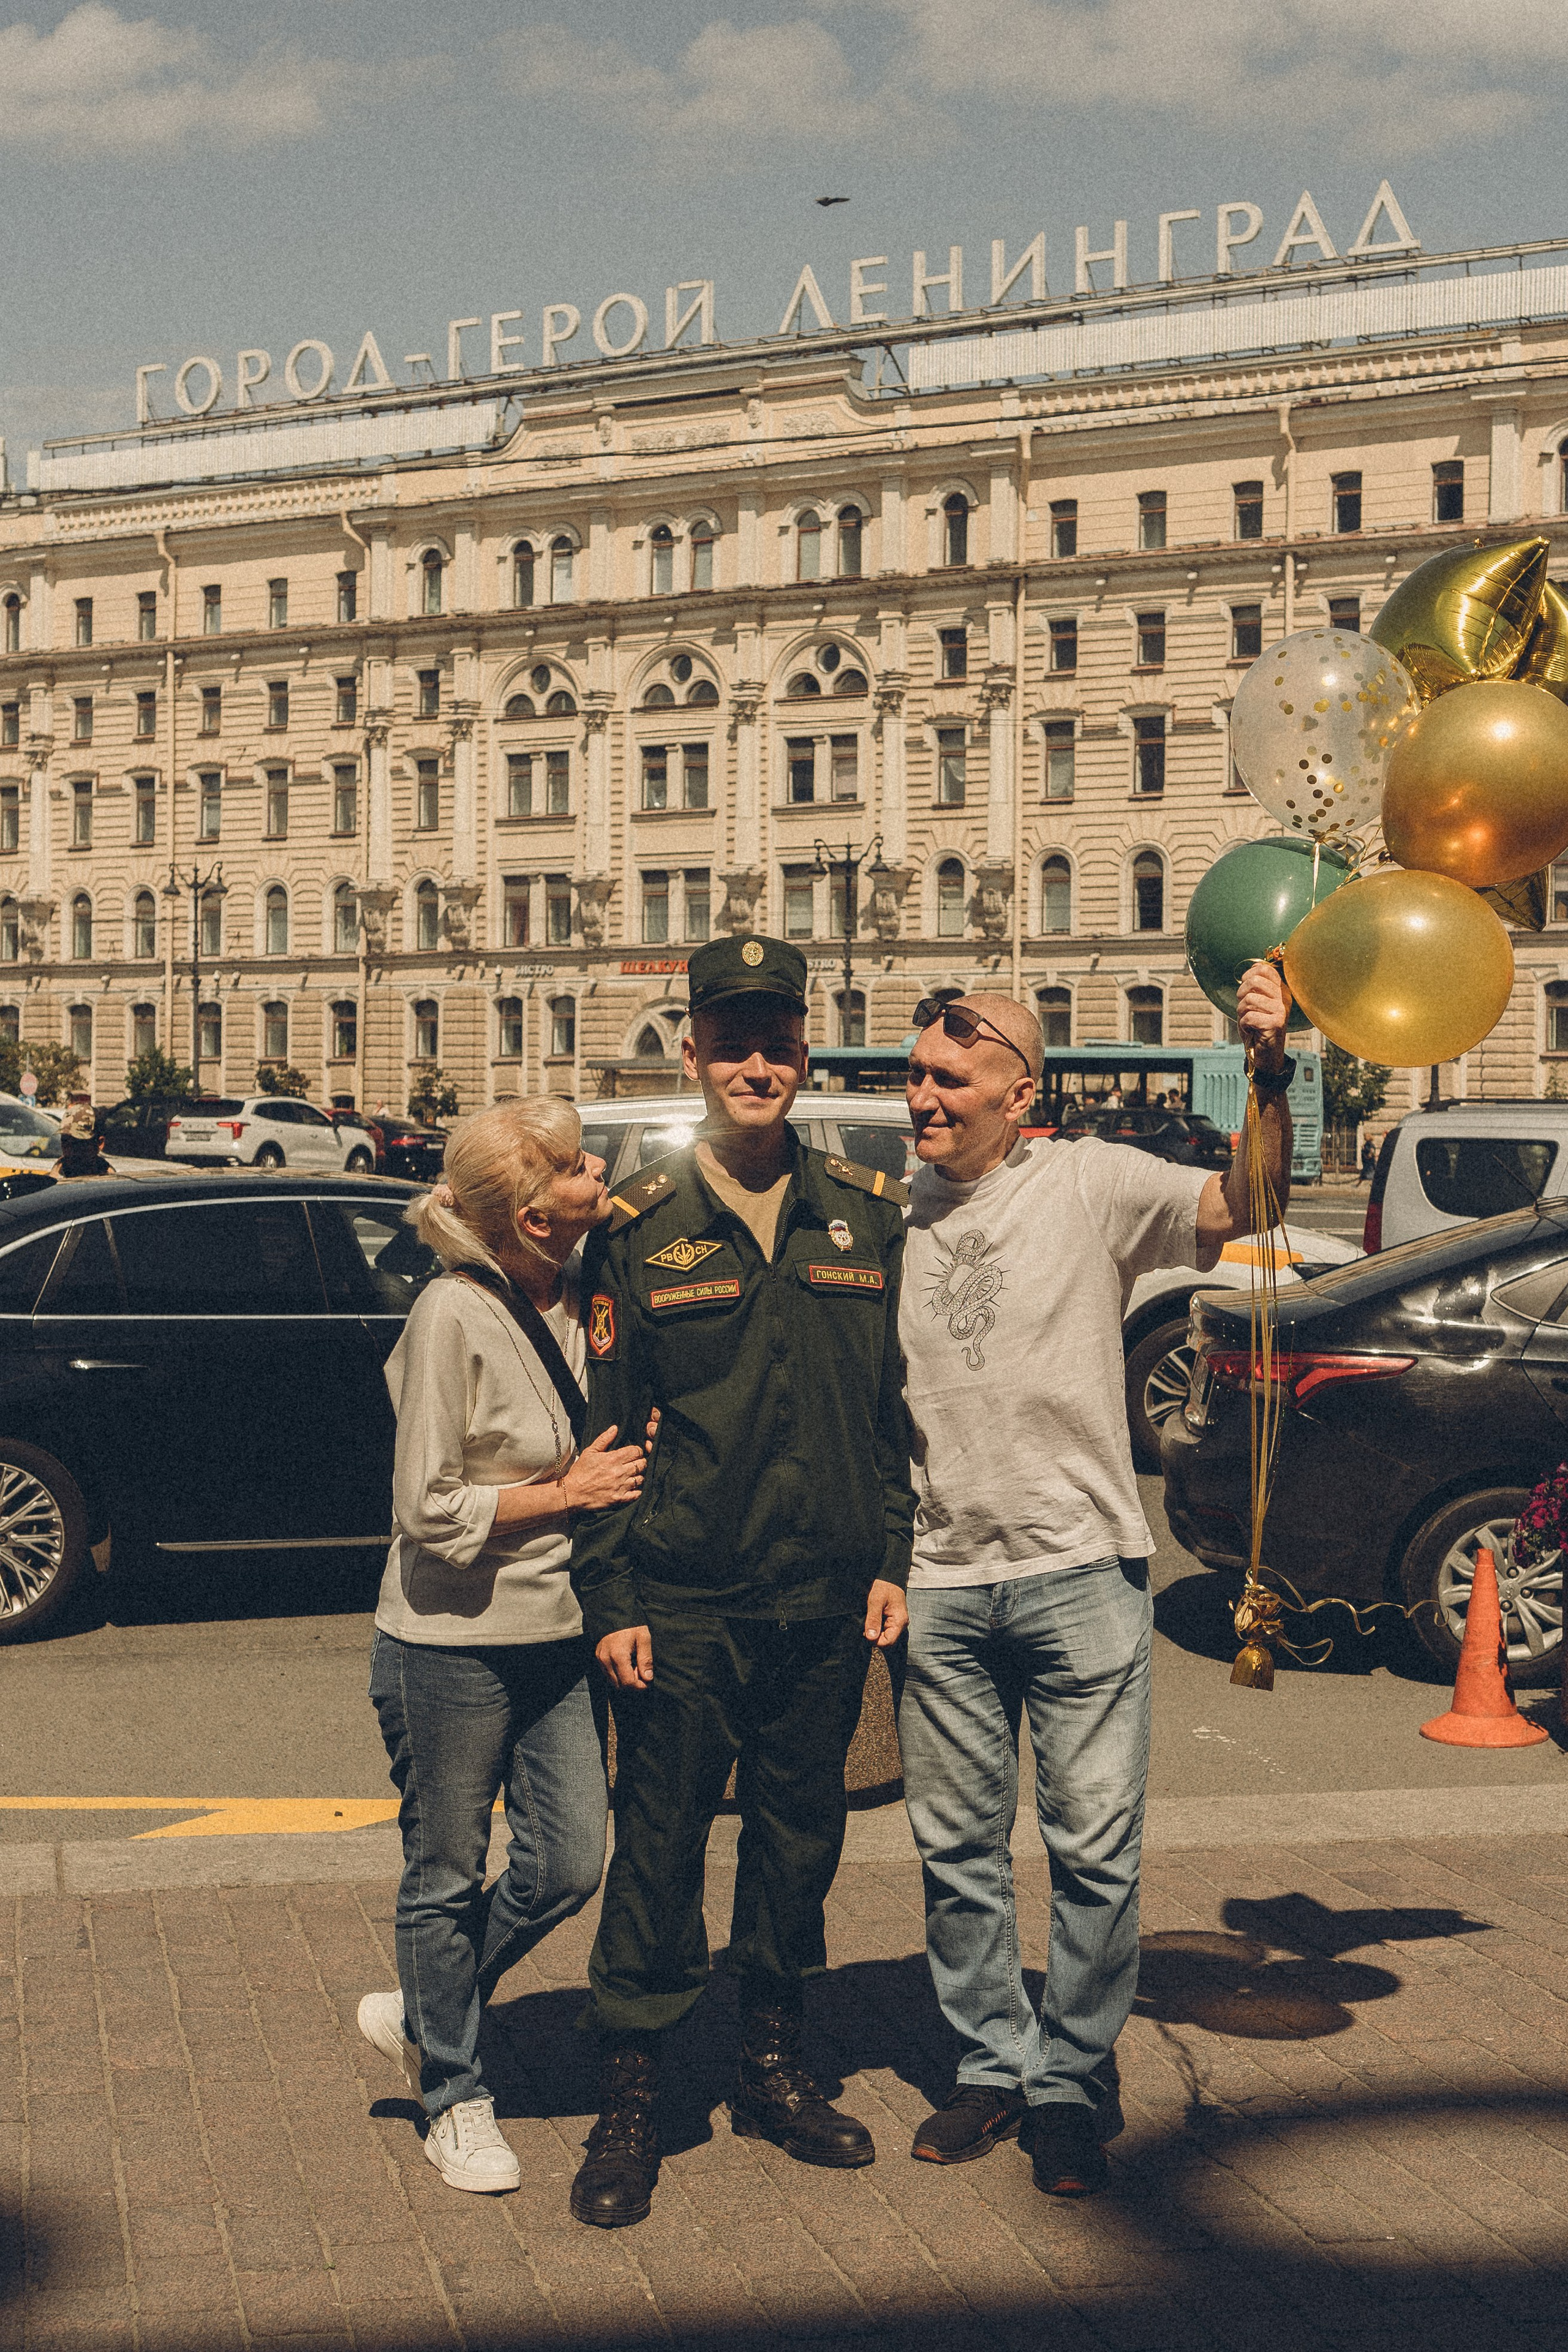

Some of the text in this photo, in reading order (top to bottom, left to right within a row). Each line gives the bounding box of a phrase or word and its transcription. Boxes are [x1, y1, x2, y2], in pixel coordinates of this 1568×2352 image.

[135, 179, 1423, 423] ГОРОД-ГЕРОЙ ЛЕНИНГРАД
[620, 960, 689, 974] ЩЕЛКУН
[807, 958, 836, 970] STRO
[660, 1245, 708, 1263] РВ СН
[816, 1270, 878, 1284] ГОНСКИЙ М.А.
[654, 1284, 736, 1304] ВООРУЖЕННЫЕ СИЛЫ РОССИИ
